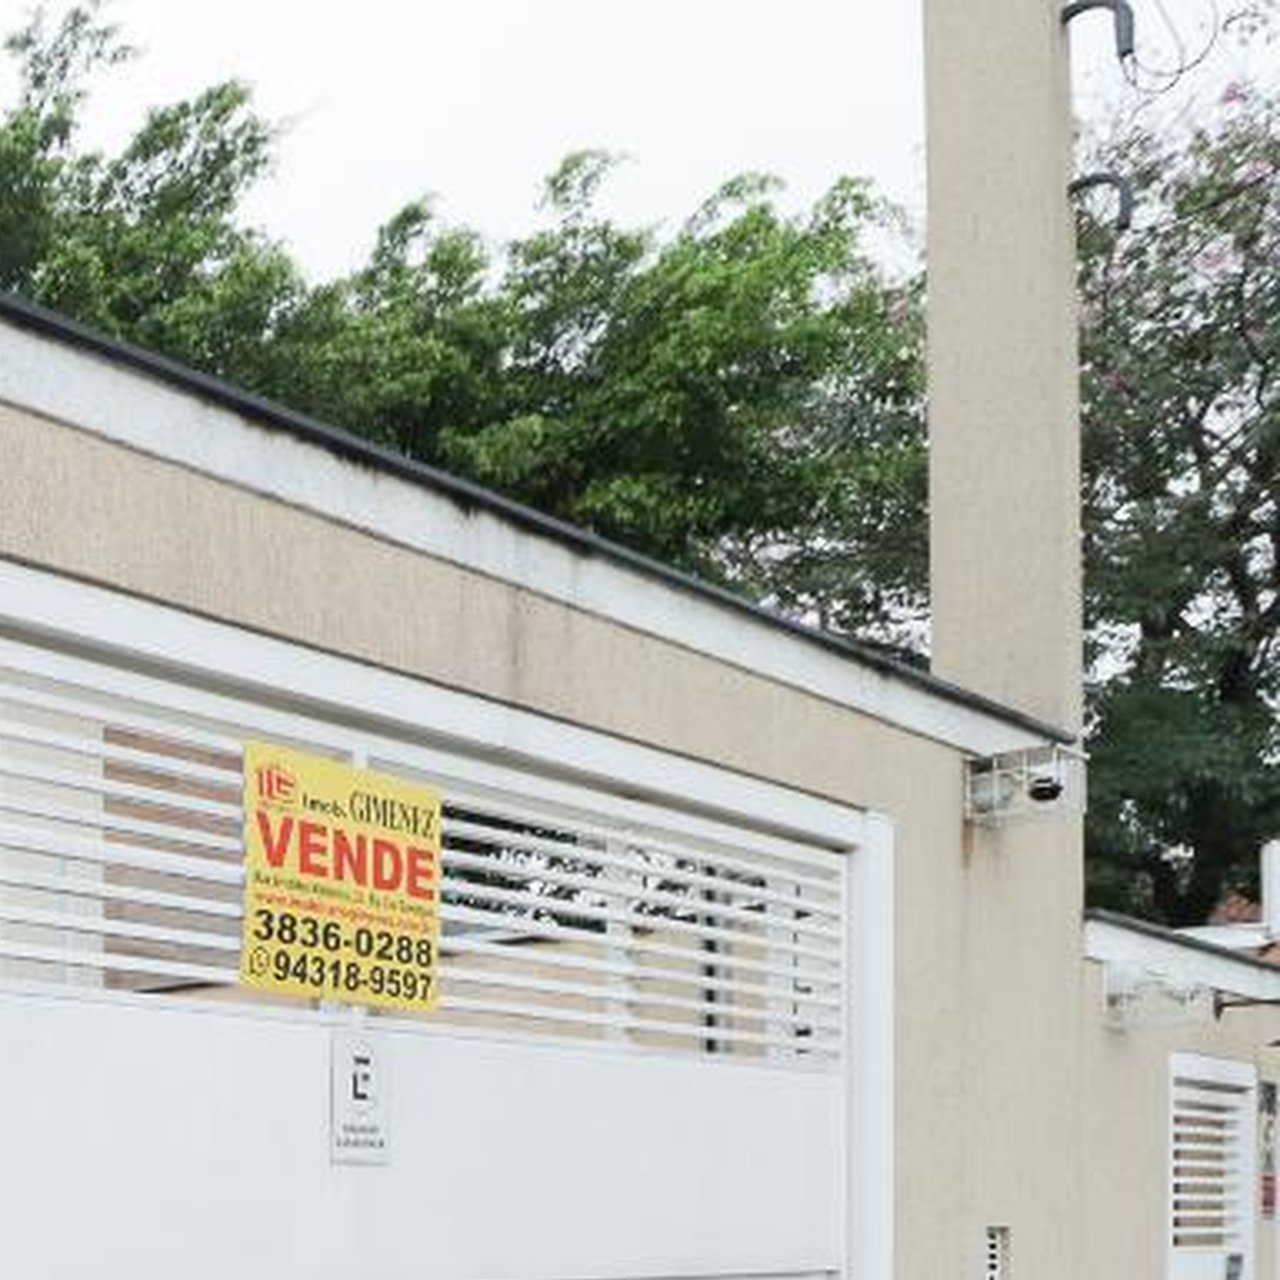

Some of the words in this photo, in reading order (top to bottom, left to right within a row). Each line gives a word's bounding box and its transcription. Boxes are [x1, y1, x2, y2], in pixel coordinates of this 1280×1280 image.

[349, 790, 435, 839] GIMENEZ
[256, 810, 436, 901] VENDE
[253, 909, 433, 968] 3836-0288
[273, 950, 433, 1001] 94318-9597
